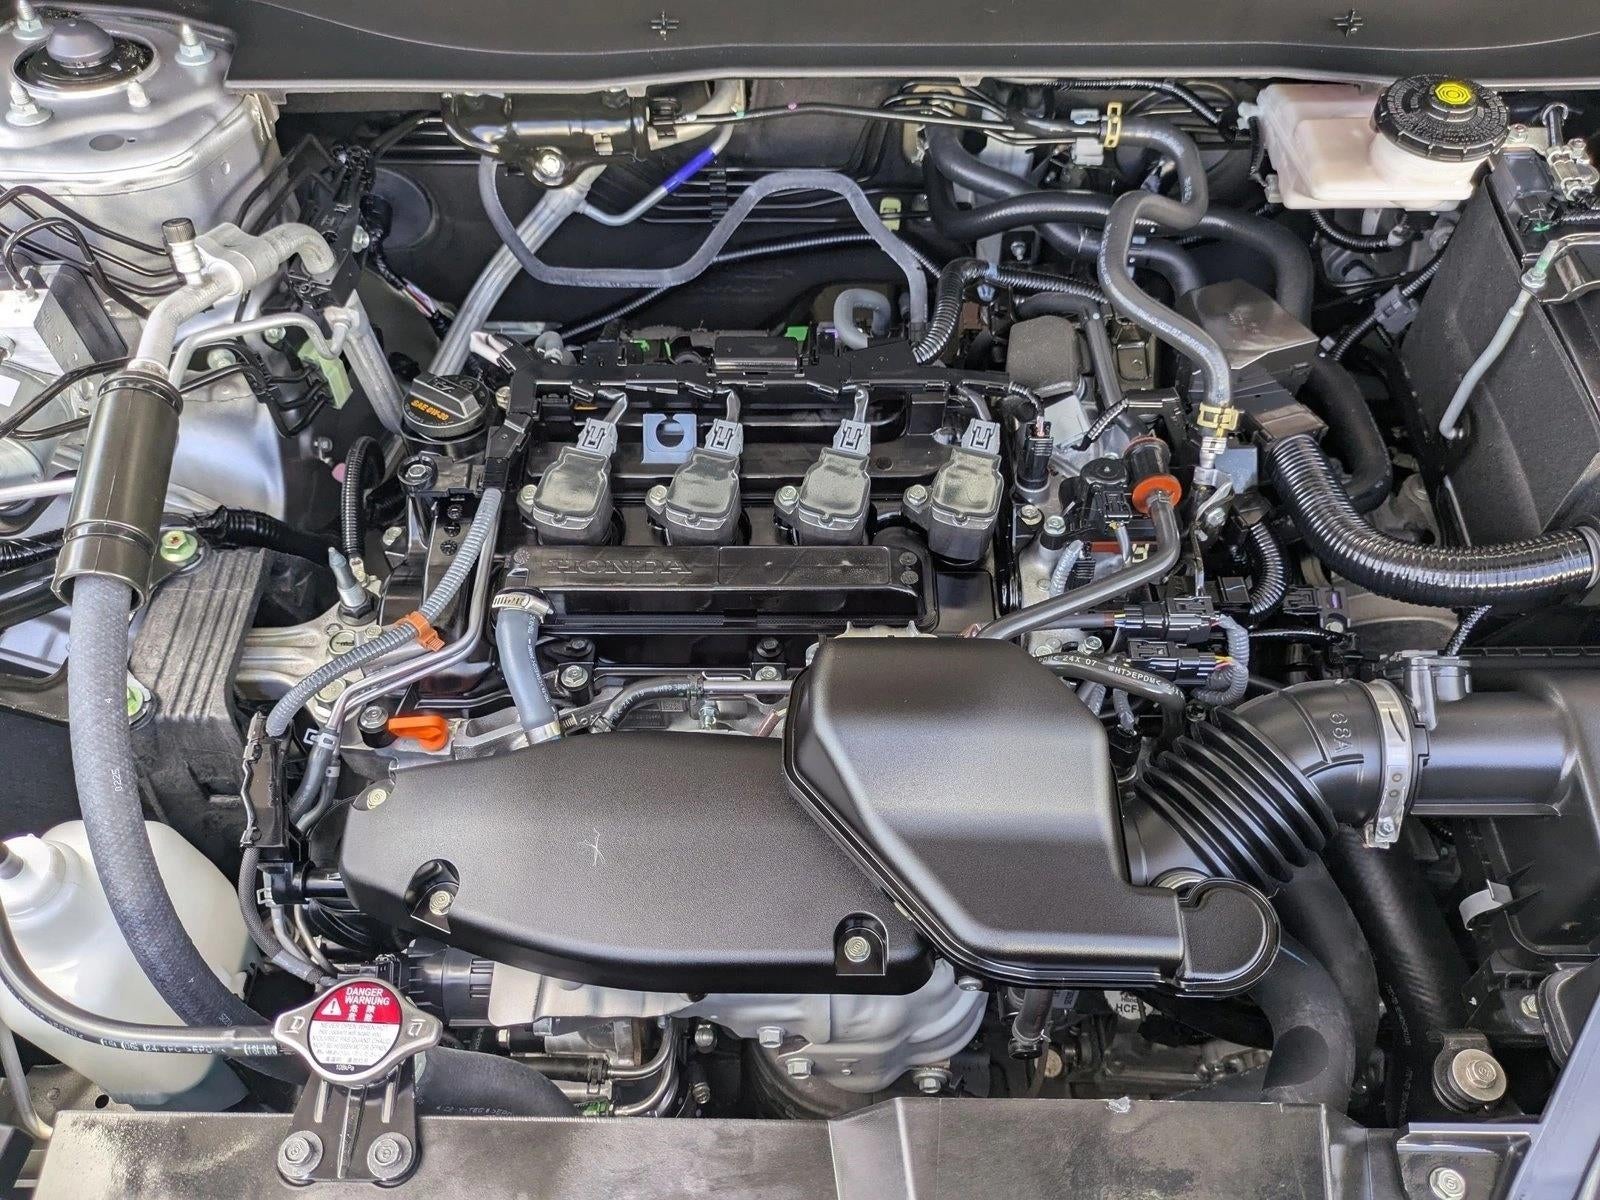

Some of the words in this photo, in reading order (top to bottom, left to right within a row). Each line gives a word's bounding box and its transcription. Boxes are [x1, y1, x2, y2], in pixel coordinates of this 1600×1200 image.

[547, 559, 692, 575] HONDA
[346, 987, 383, 997] DANGER
[345, 996, 390, 1006] WARNUNG
